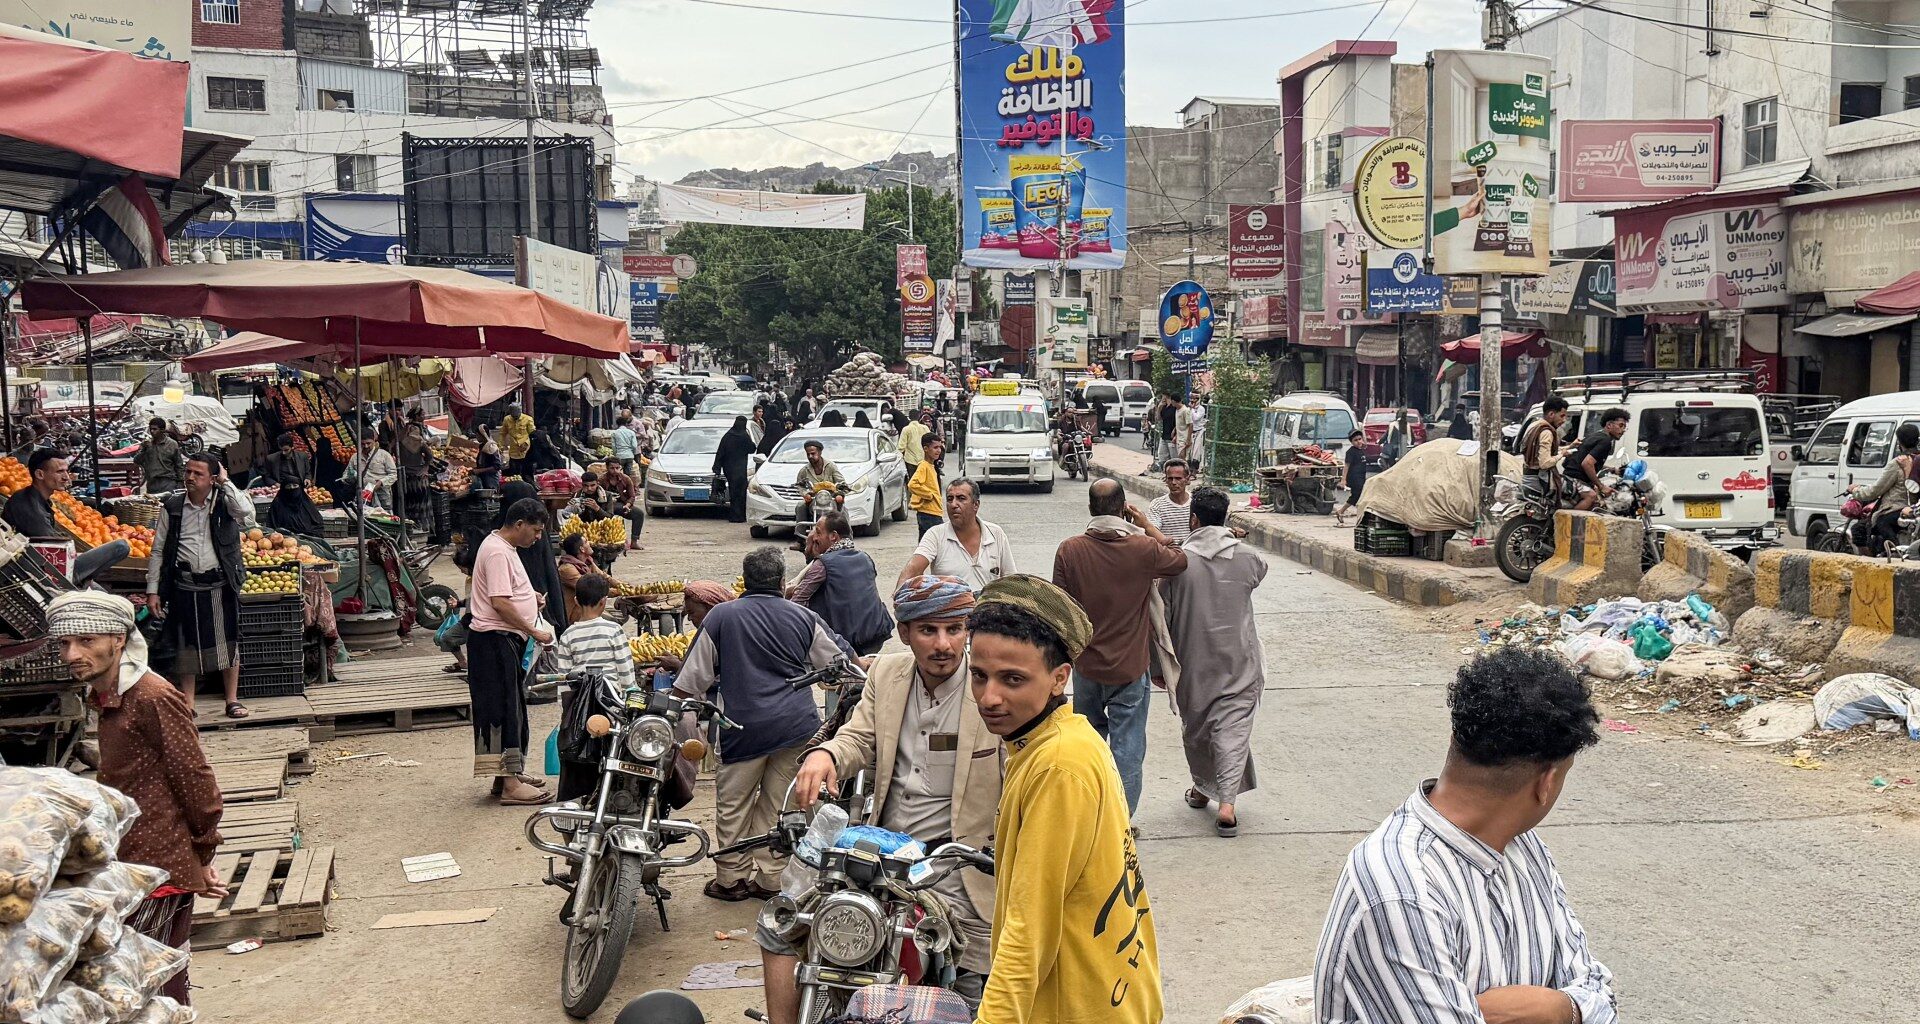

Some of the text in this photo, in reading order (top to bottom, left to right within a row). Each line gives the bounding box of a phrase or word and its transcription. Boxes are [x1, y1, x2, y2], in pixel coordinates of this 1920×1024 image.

[89, 16, 118, 26] طبيعي
[1006, 47, 1083, 83] ملك
[998, 79, 1091, 117] النظافة
[1513, 99, 1536, 113] عبوات
[1493, 110, 1518, 125] الجديدة
[997, 111, 1094, 147] والتوفير
[1382, 142, 1404, 155] للصرافة
[1405, 143, 1419, 151] غنام
[1470, 143, 1494, 163] 5 كيلو
[1575, 140, 1627, 166] النجم
[1653, 140, 1709, 158] الأيوبي
[1362, 155, 1384, 192] والتحويلات
[1240, 233, 1275, 243] مجموعة
[1670, 220, 1709, 251] الأيوبي
[1726, 230, 1785, 245] UNMoney
[1231, 243, 1283, 253] الطاهري التجارية
[1337, 254, 1361, 268] ارت
[1620, 260, 1656, 277] UNMoney
[1725, 259, 1783, 284] الأيوبي
[1384, 287, 1401, 296] نظافة
[1426, 287, 1432, 295] لا
[1676, 279, 1705, 290] 04-250895
[1726, 284, 1778, 297] والتحويلات
[1402, 287, 1410, 298] في
[1410, 287, 1425, 297] يشارك
[1370, 299, 1386, 310] فيها
[1179, 331, 1194, 344] أصل
